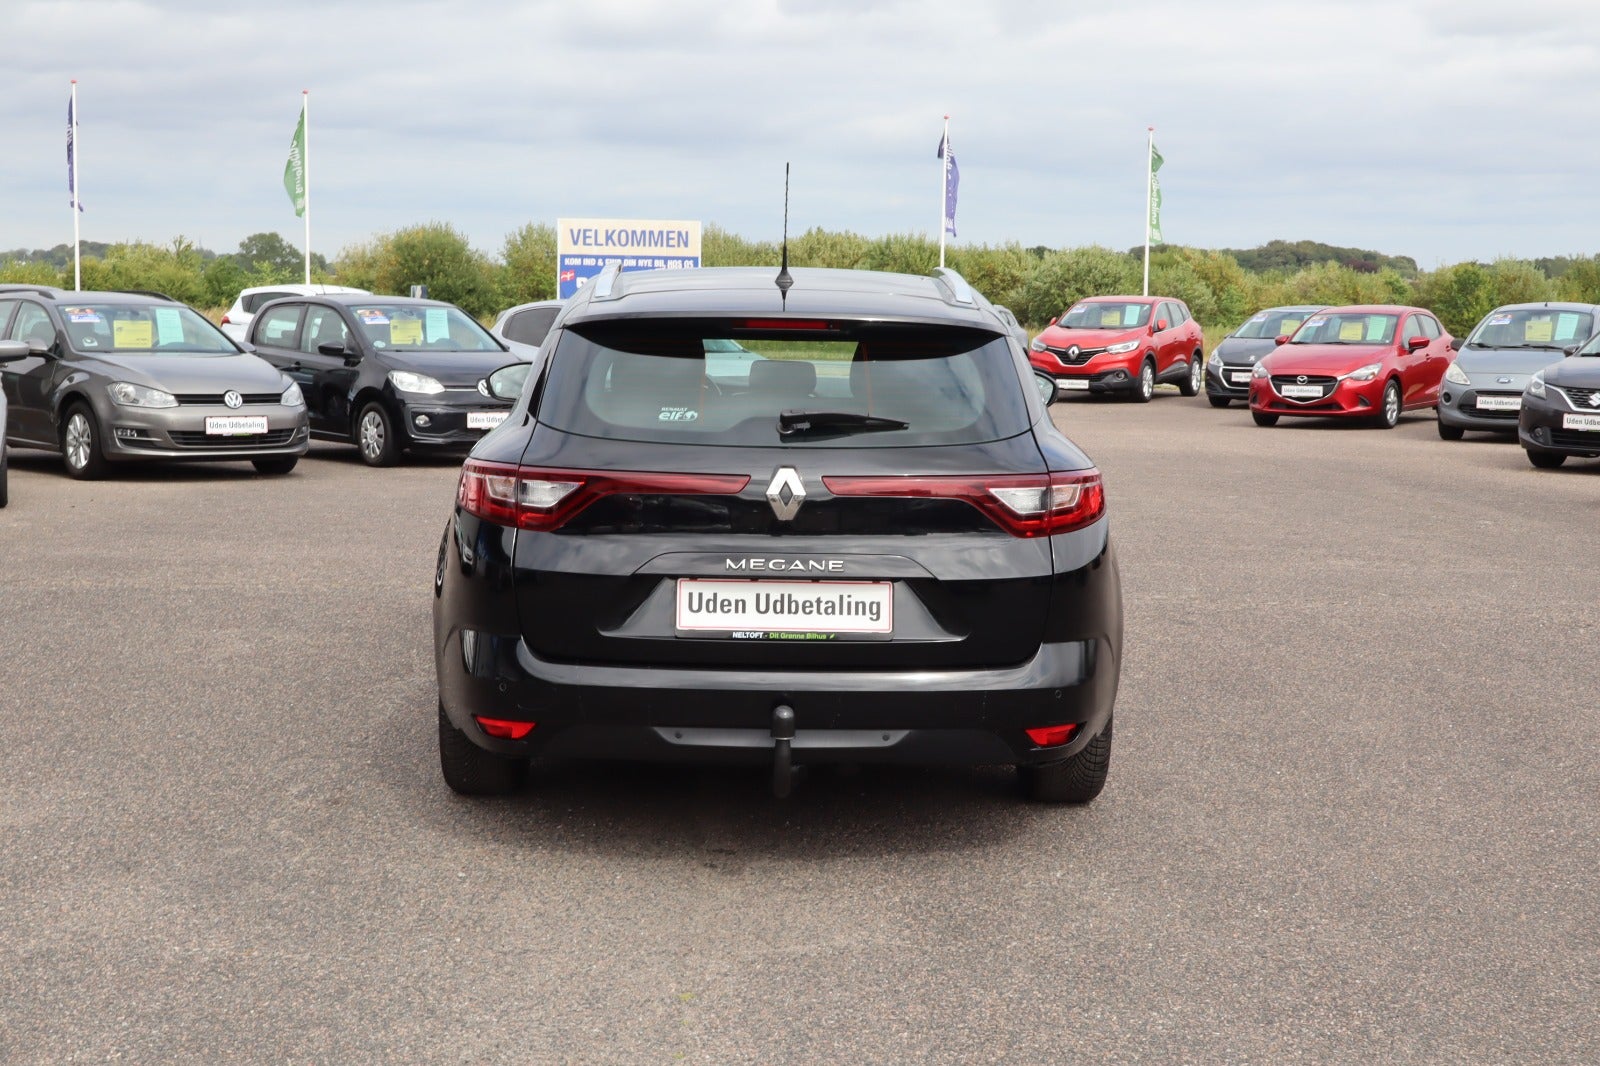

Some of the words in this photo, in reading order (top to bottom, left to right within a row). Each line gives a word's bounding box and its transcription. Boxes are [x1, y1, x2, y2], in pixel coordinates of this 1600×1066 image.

[569, 228, 689, 248] VELKOMMEN
[565, 257, 581, 266] KOM
[583, 257, 596, 266] IND
[623, 259, 637, 267] DIN
[638, 259, 653, 267] NYE
[725, 558, 845, 572] MEGANE
[688, 591, 747, 614] Uden
[755, 593, 882, 622] Udbetaling
[732, 631, 764, 639] NELTOFT
